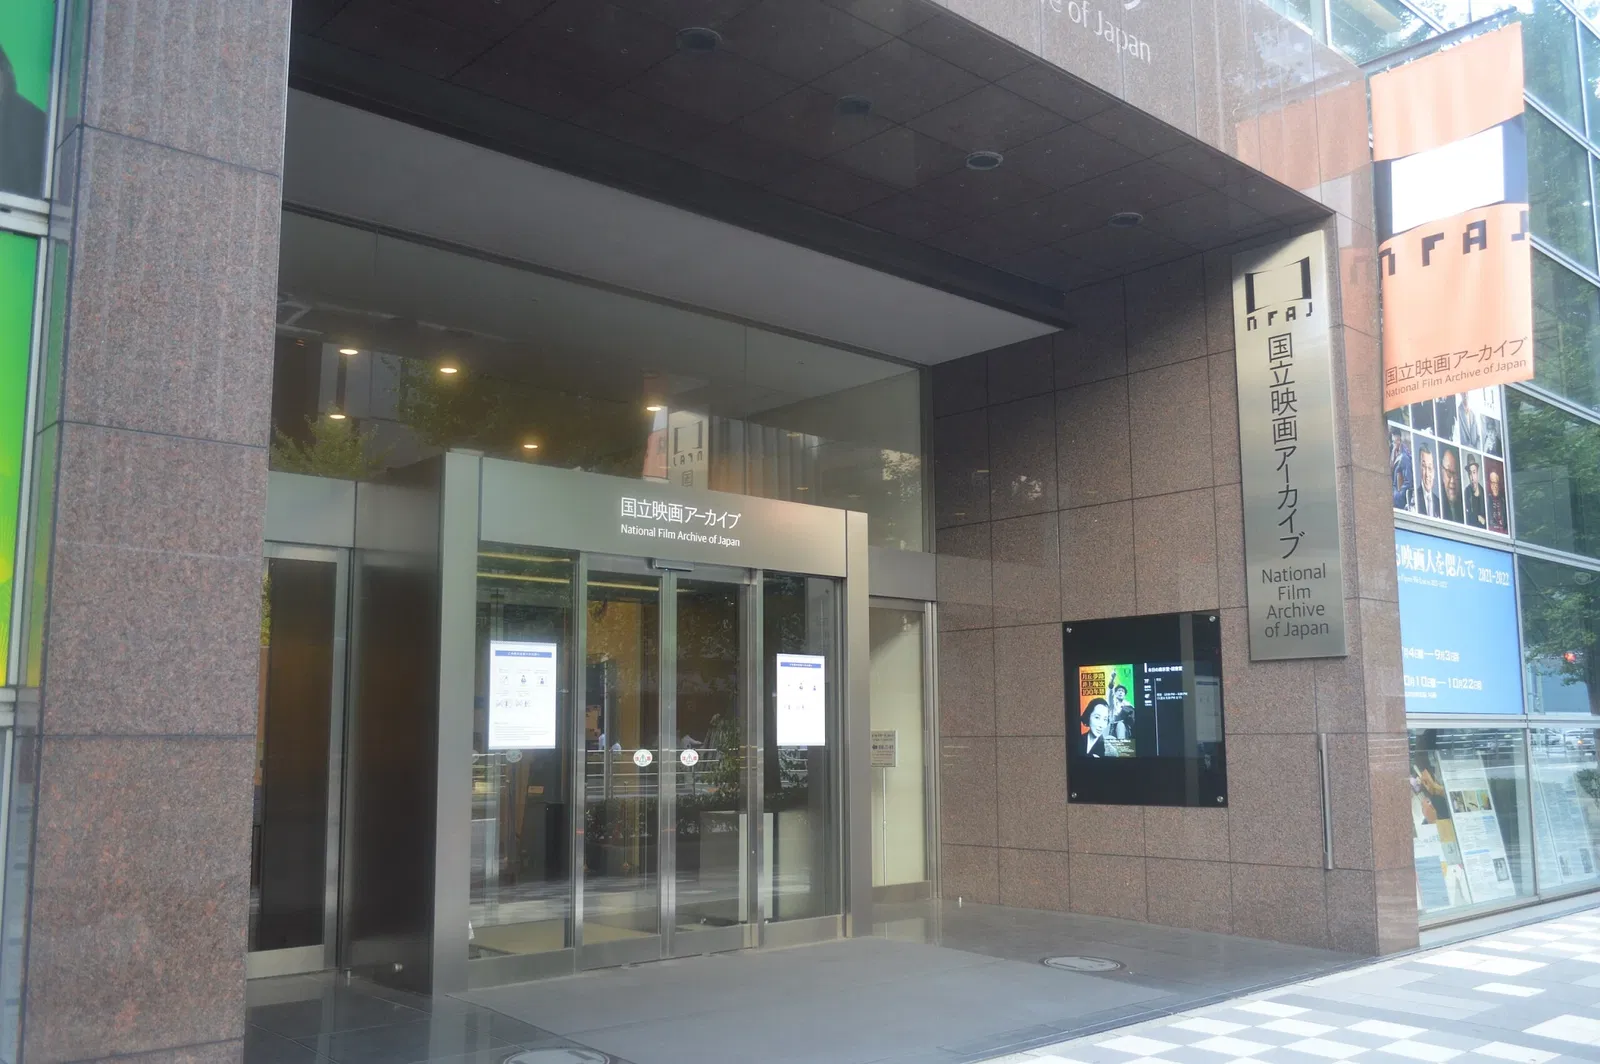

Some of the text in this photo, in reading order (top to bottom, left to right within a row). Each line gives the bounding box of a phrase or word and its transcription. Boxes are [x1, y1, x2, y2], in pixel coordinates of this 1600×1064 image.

[1068, 0, 1151, 64] of Japan
[1385, 336, 1527, 386] 国立映画アーカイブ
[1385, 359, 1526, 398] National Film Archive of Japan
[1267, 332, 1305, 560] 国立映画アーカイブ
[621, 497, 741, 529] 国立映画アーカイブ
[621, 524, 740, 547] National Film Archive of Japan
[1262, 563, 1326, 583] National
[1278, 585, 1311, 601] Film
[1266, 602, 1325, 619] Archive
[1264, 621, 1329, 640] of Japan
